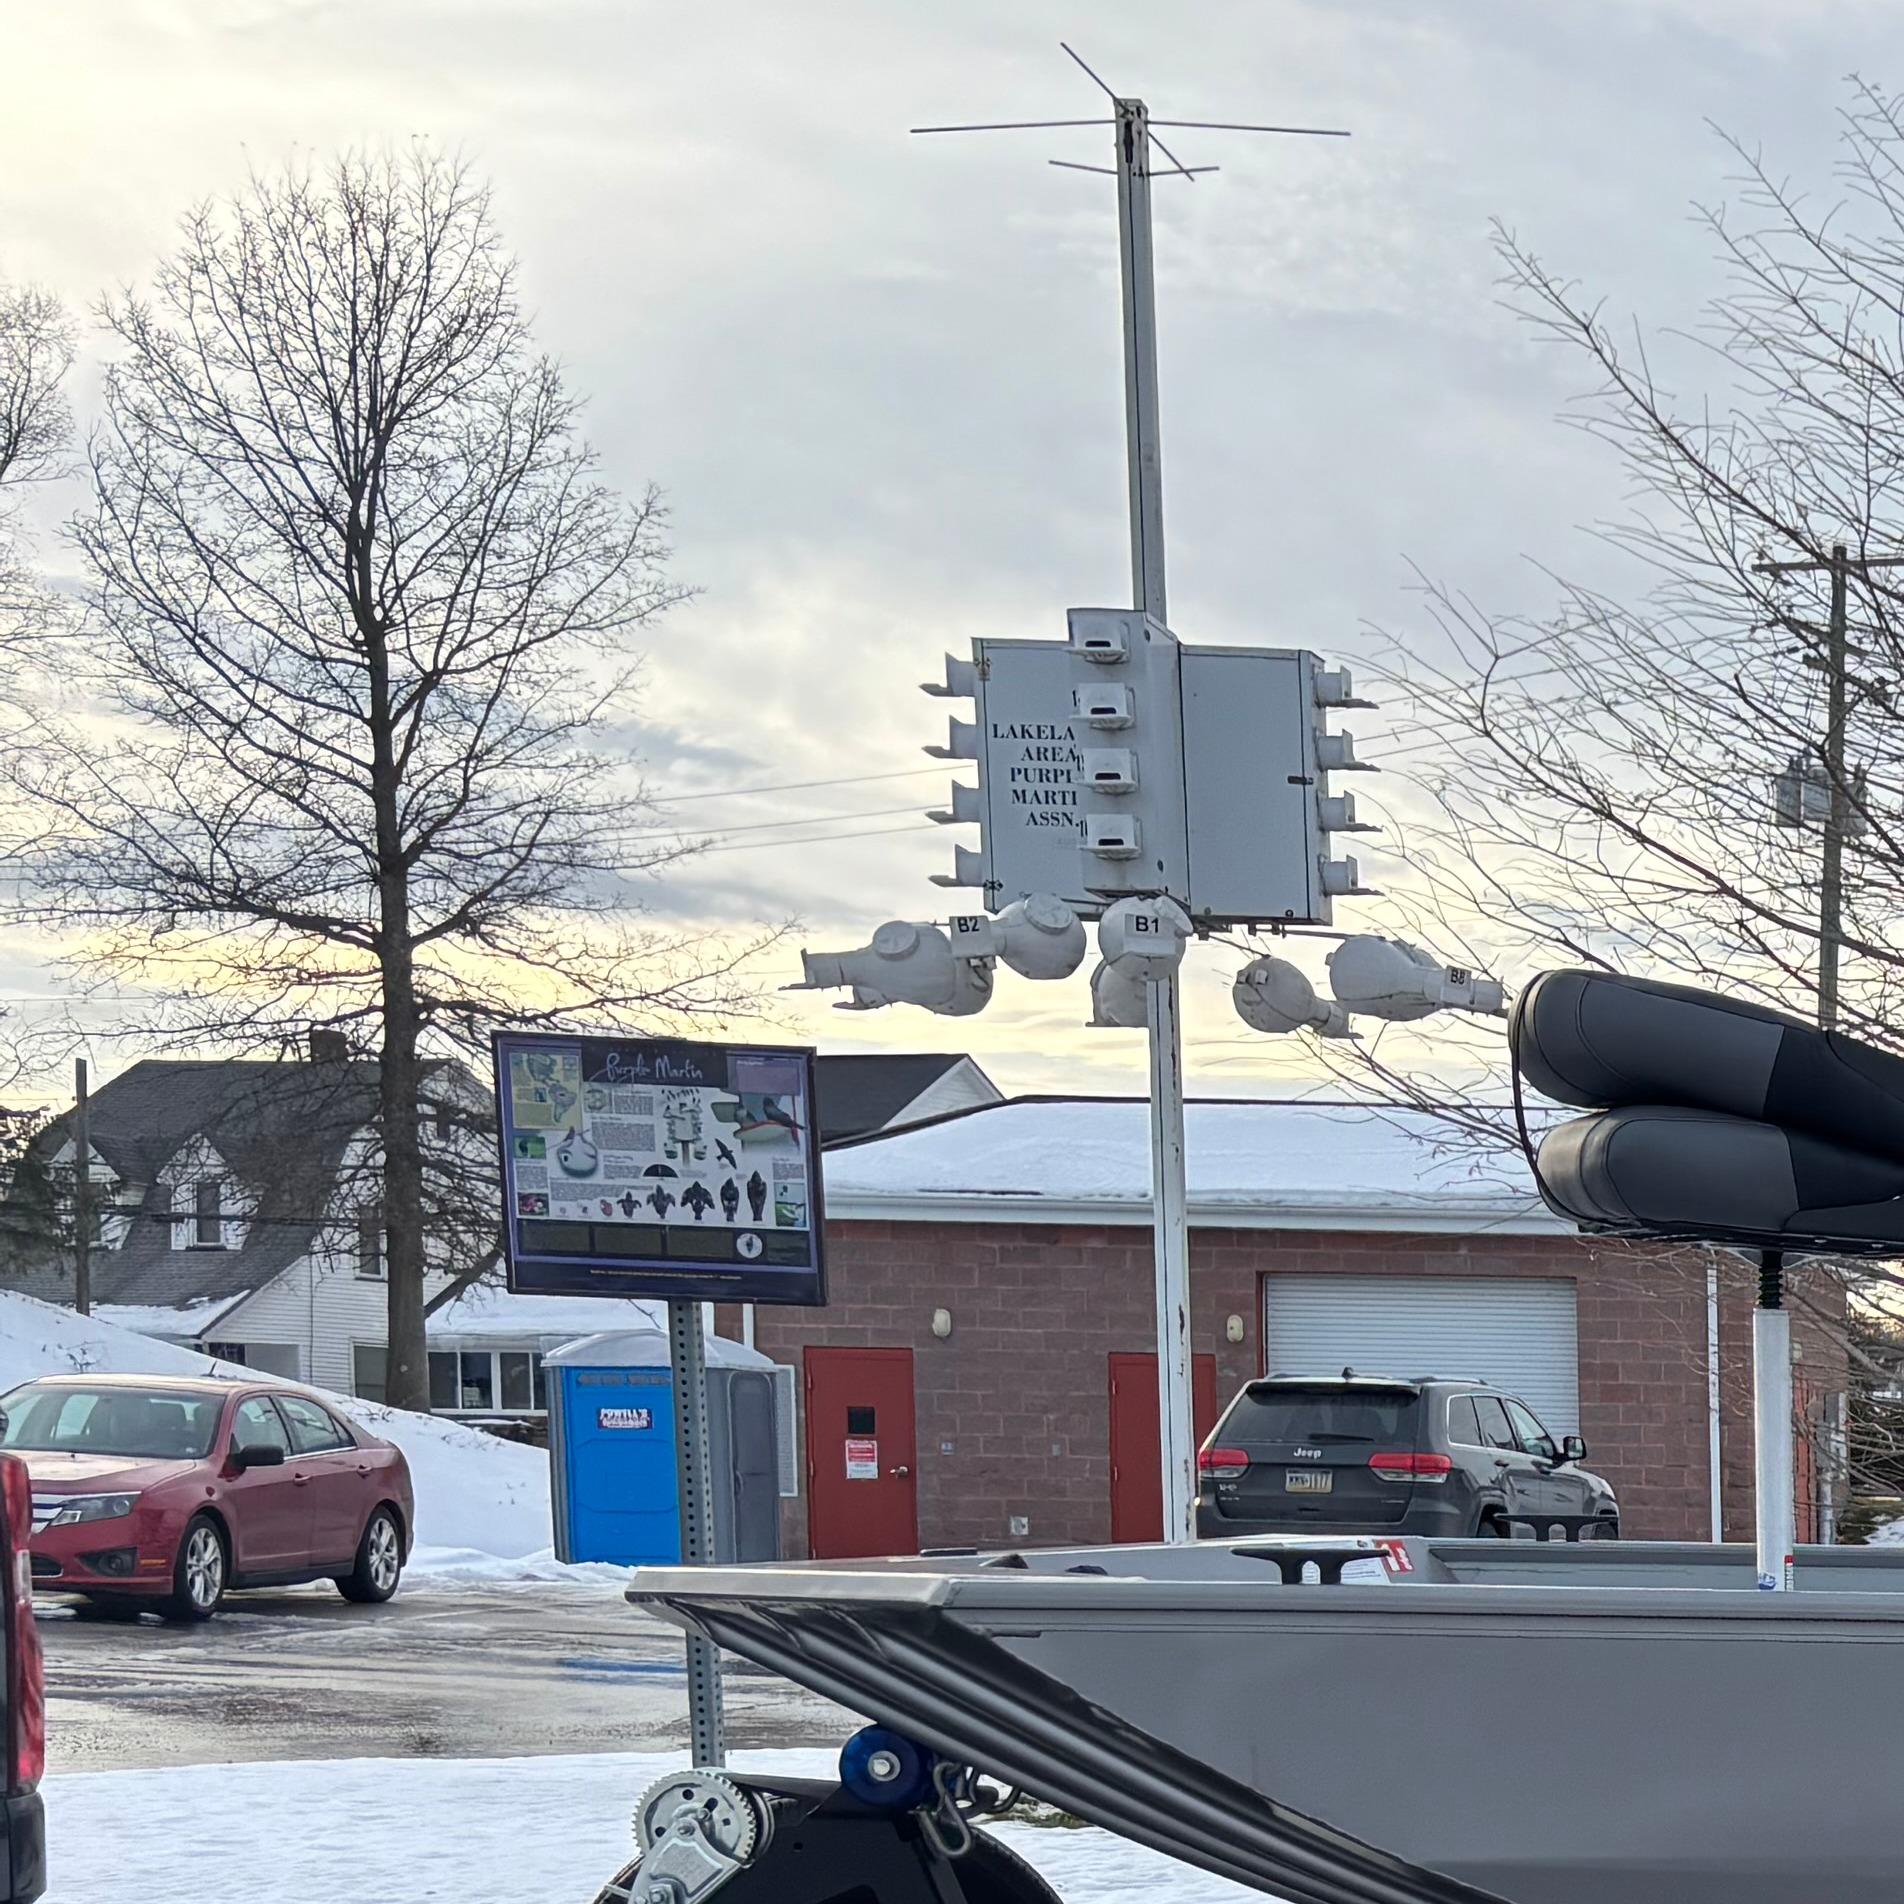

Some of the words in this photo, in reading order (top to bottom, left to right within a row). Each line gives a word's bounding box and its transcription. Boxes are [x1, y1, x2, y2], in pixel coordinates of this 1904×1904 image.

[992, 723, 1075, 740] LAKELA
[1021, 746, 1077, 762] AREA
[1012, 789, 1077, 806] MARTI
[1026, 811, 1080, 827] ASSN.
[957, 916, 980, 933] B2
[1135, 915, 1159, 933] B1
[656, 1055, 703, 1079] Martin
[1293, 1447, 1322, 1460] Jeep
